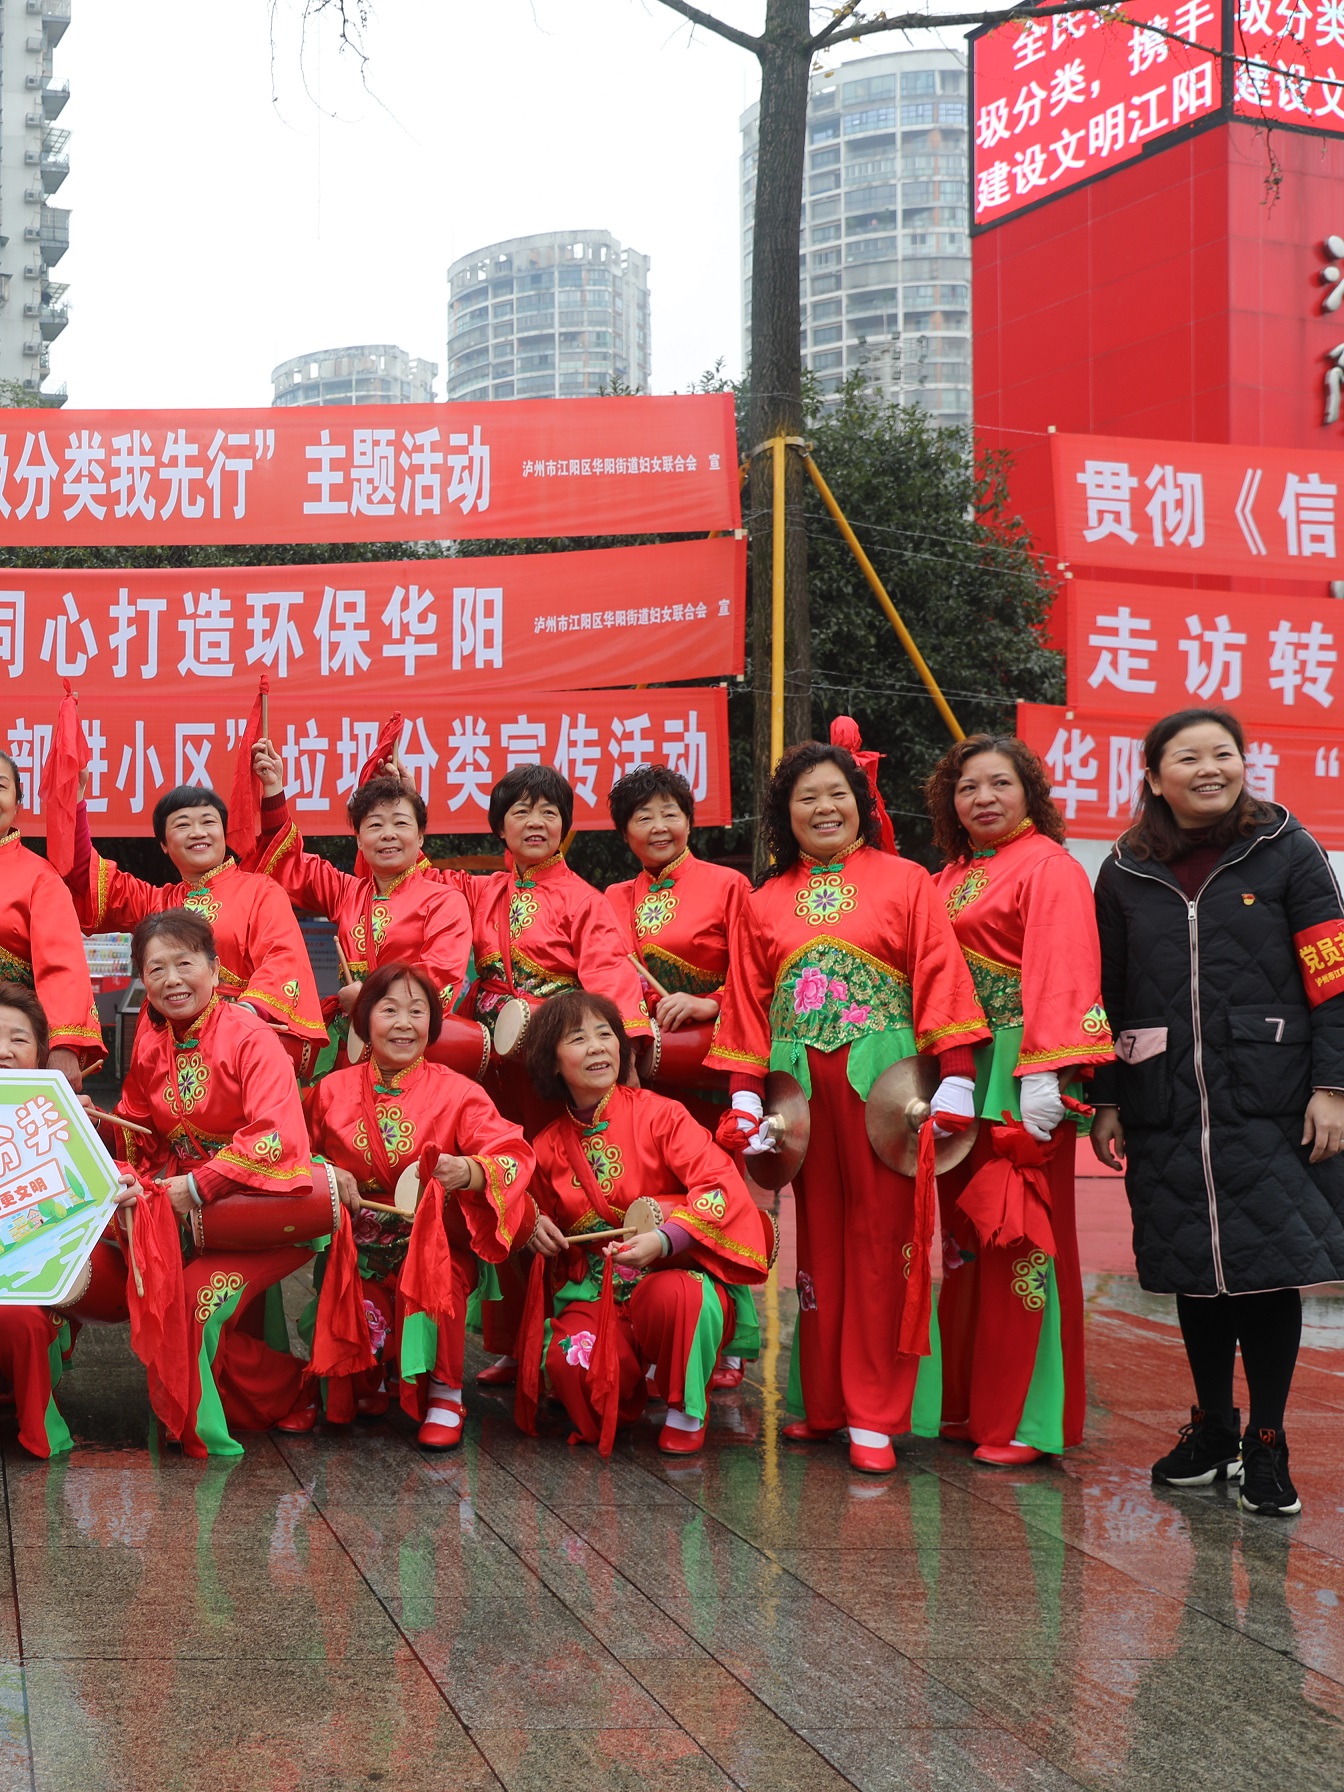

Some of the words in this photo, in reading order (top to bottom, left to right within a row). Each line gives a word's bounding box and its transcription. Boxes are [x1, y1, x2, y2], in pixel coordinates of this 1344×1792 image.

[977, 61, 1213, 213] 建设文明江阳
[522, 454, 697, 477] 泸州市江阳区华阳街道妇女联合会
[708, 453, 721, 471] 宣
[534, 602, 707, 633] 泸州市江阳区华阳街道妇女联合会
[717, 599, 730, 616] 宣
[1088, 607, 1338, 708] 走访转
